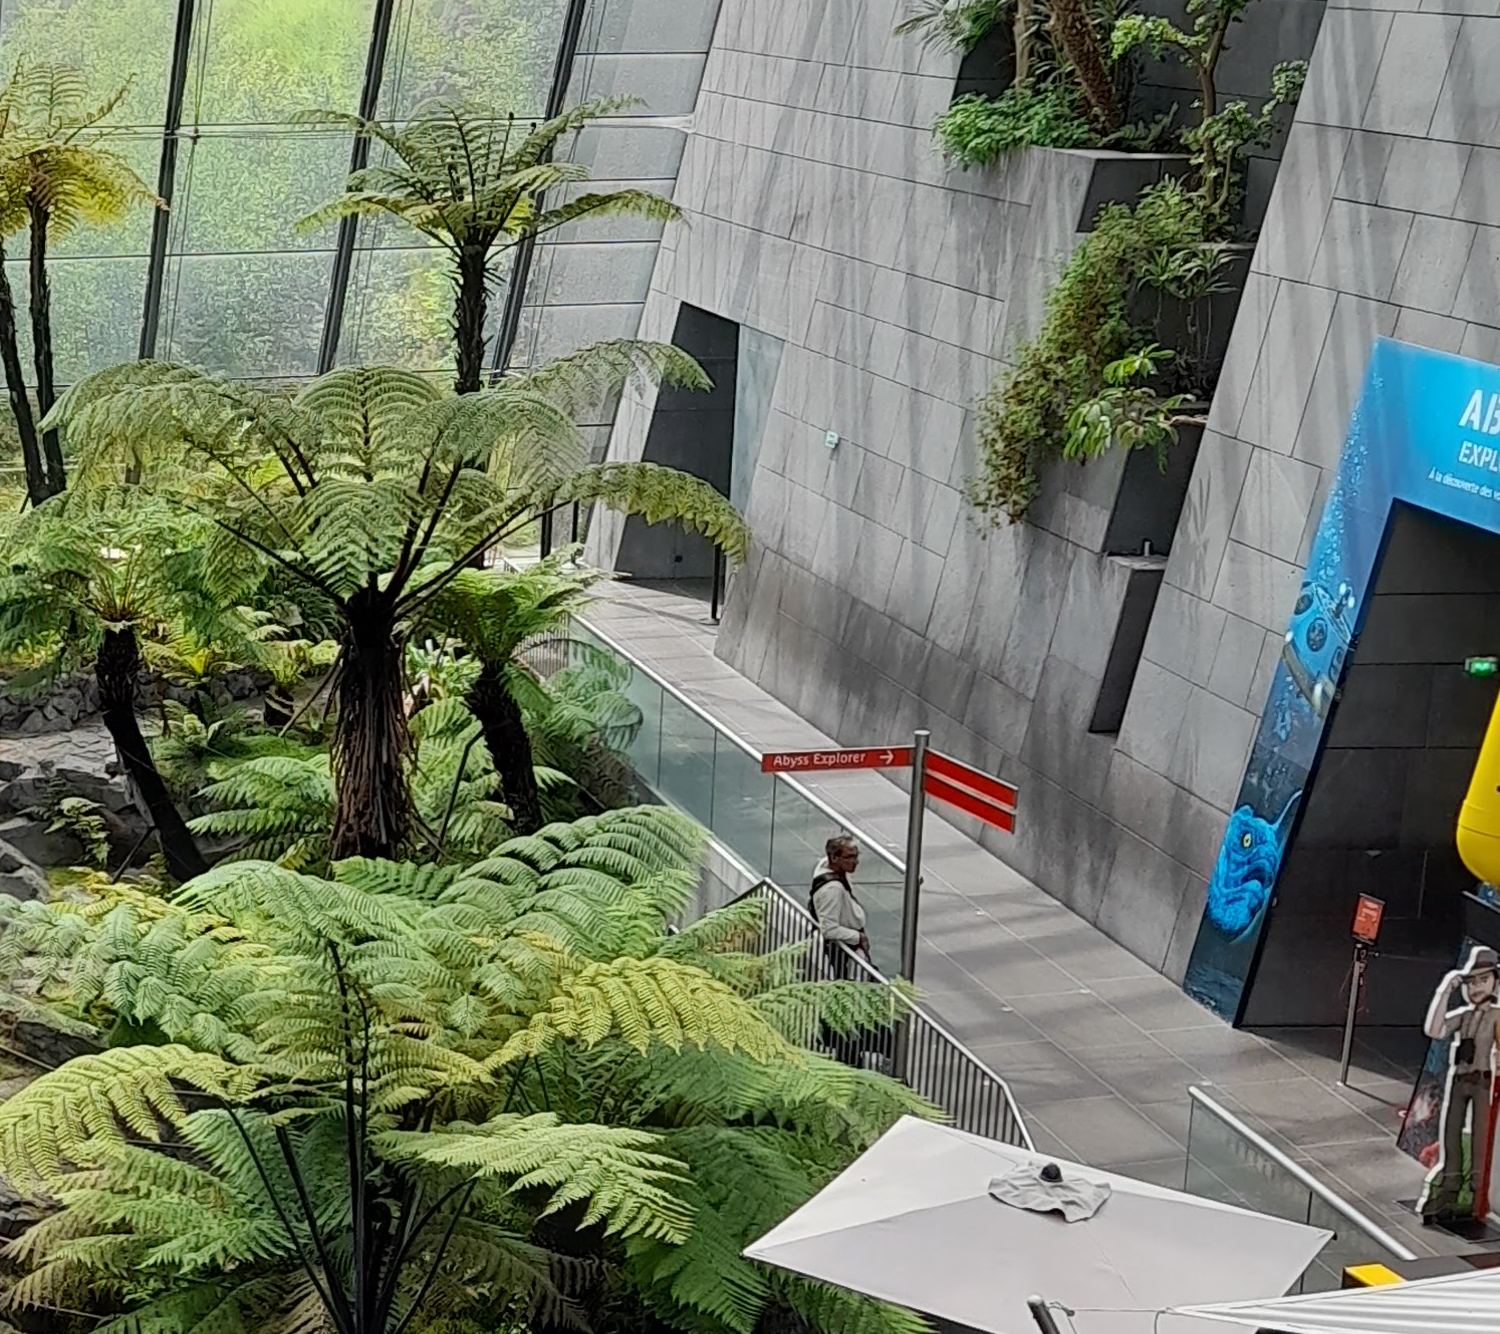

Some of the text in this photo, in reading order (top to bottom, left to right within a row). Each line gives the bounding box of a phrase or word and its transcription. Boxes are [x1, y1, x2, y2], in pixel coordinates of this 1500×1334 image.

[1459, 440, 1500, 473] EXPL
[773, 752, 866, 768] Abyss Explorer
